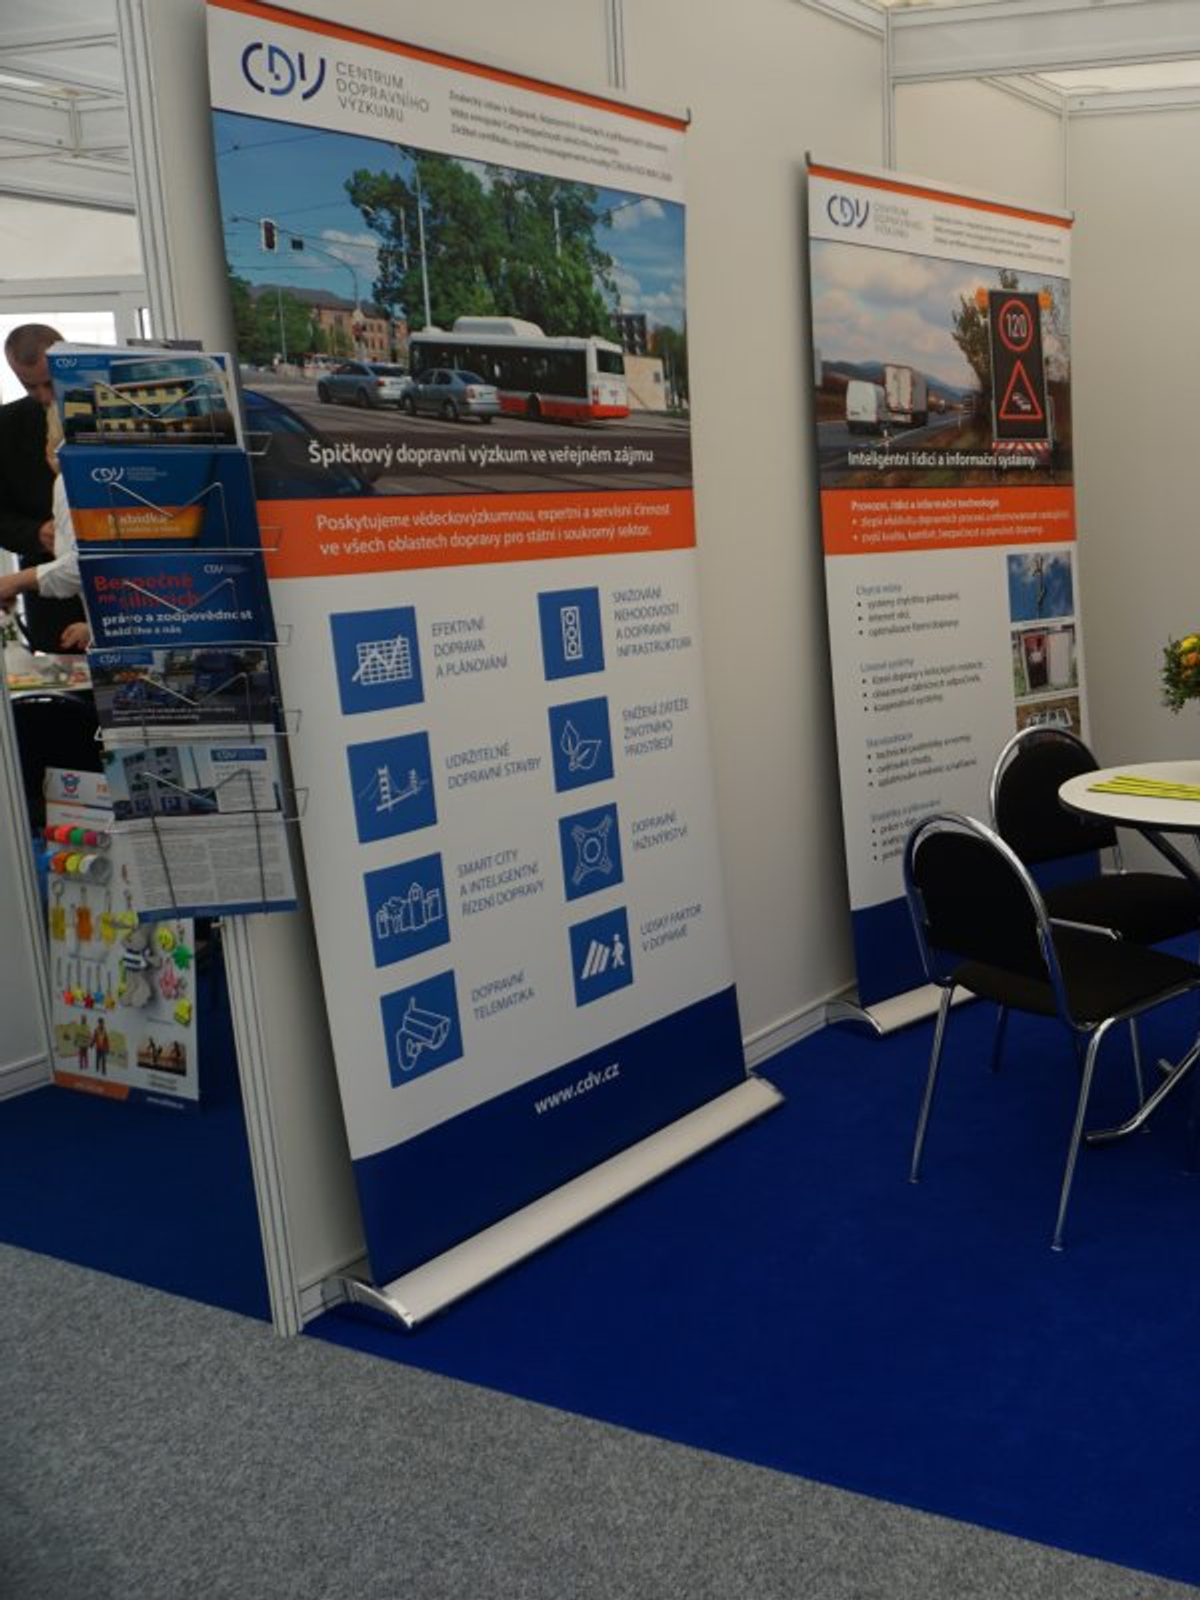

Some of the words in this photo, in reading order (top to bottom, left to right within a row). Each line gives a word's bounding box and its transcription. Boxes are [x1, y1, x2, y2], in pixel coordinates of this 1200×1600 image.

[336, 61, 404, 89] CENTRUM
[336, 78, 430, 113] DOPRAVNÍHO
[338, 94, 404, 122] VÝZKUMU
[1006, 313, 1027, 338] 120
[308, 440, 393, 468] Špičkový
[396, 443, 465, 468] dopravní
[468, 445, 528, 467] výzkum
[531, 449, 549, 463] ve
[549, 445, 611, 467] veřejném
[615, 445, 654, 467] zájmu
[847, 451, 909, 470] Inteligentní
[938, 454, 944, 466] a
[999, 454, 1037, 470] systémy
[316, 513, 411, 533] Poskytujeme
[582, 508, 589, 519] a
[320, 542, 339, 556] ve
[344, 537, 386, 554] všech
[388, 533, 447, 552] oblastech
[450, 531, 500, 547] dopravy
[504, 531, 523, 546] pro
[614, 603, 679, 621] NEHODOVOSTI
[431, 616, 485, 638] EFEKTIVNÍ
[616, 629, 624, 640] A
[433, 638, 485, 658] DOPRAVA
[436, 664, 444, 679] A
[445, 655, 508, 677] PLÁNOVÁNÍ
[504, 757, 542, 777] STAVBY
[457, 854, 493, 879] SMART
[496, 848, 518, 867] CITY
[460, 883, 468, 897] A
[469, 861, 539, 893] INTELIGENTNÍ
[499, 880, 545, 907] DOPRAVY
[642, 938, 649, 952] V
[473, 987, 535, 1021] TELEMATIKA
[534, 1062, 621, 1116] www.cdv.cz
